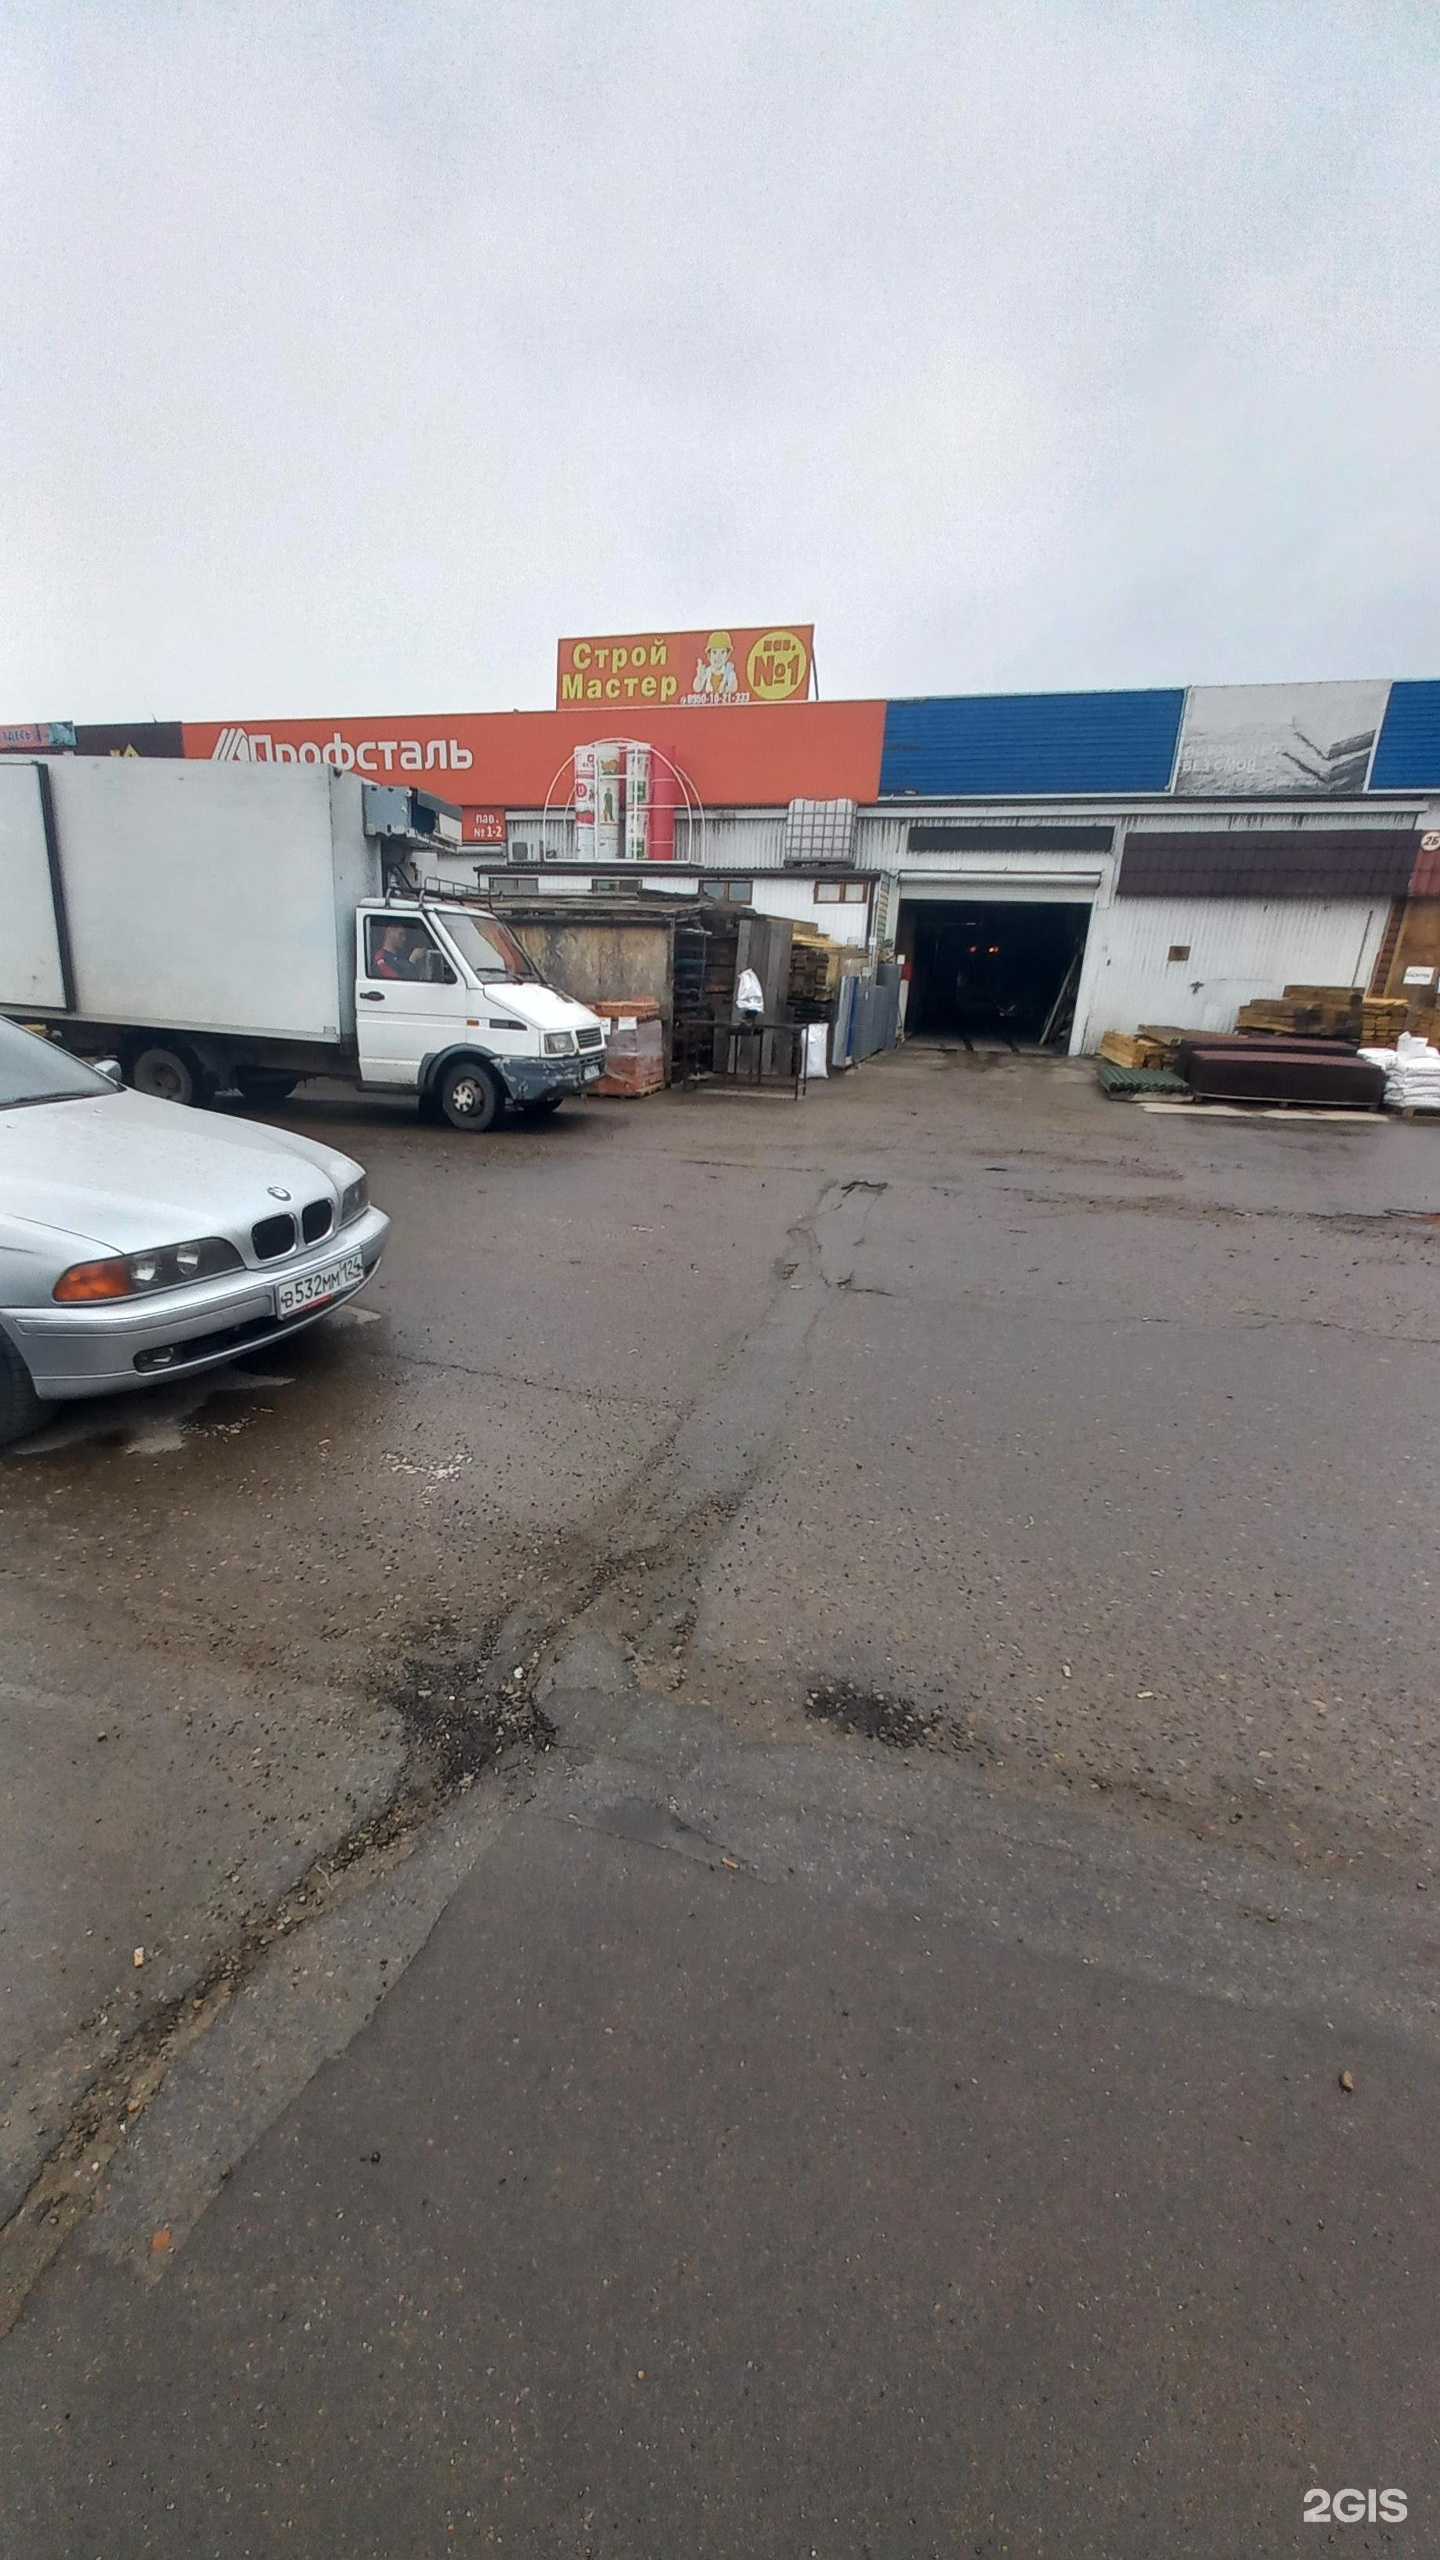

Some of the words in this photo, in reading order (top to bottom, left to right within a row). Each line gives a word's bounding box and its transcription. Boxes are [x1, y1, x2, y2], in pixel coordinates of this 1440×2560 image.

[573, 638, 668, 673] Строй
[753, 653, 800, 688] №1
[561, 674, 678, 701] Мастер
